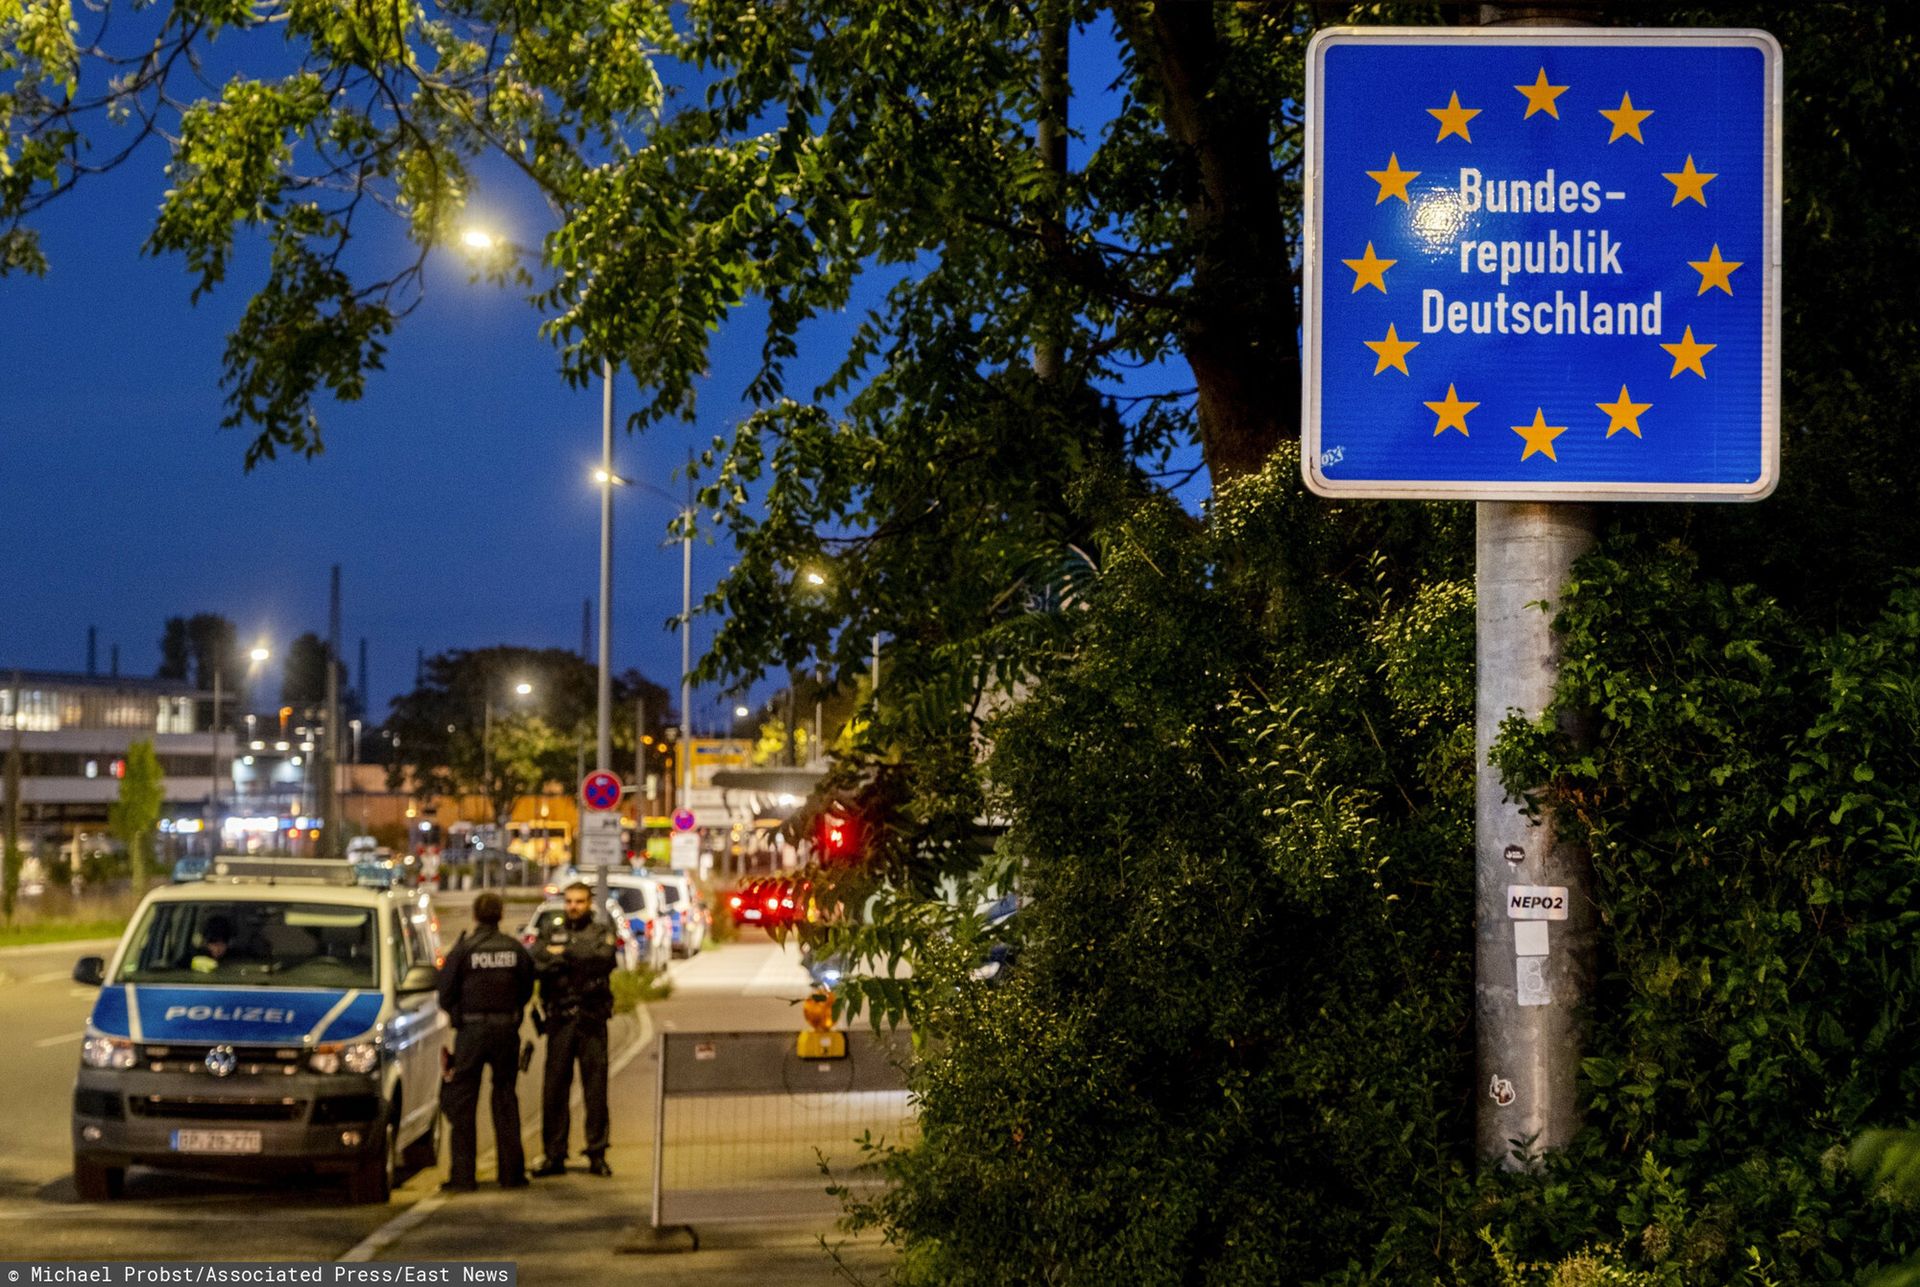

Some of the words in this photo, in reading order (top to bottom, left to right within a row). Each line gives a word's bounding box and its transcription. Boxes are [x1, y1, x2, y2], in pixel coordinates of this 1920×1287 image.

[1459, 167, 1626, 214] Bundes-
[1459, 229, 1624, 286] republik
[1421, 289, 1663, 336] Deutschland
[1511, 896, 1564, 910] NEPO2
[471, 951, 518, 970] POLIZEI
[165, 1006, 295, 1024] POLIZEI
